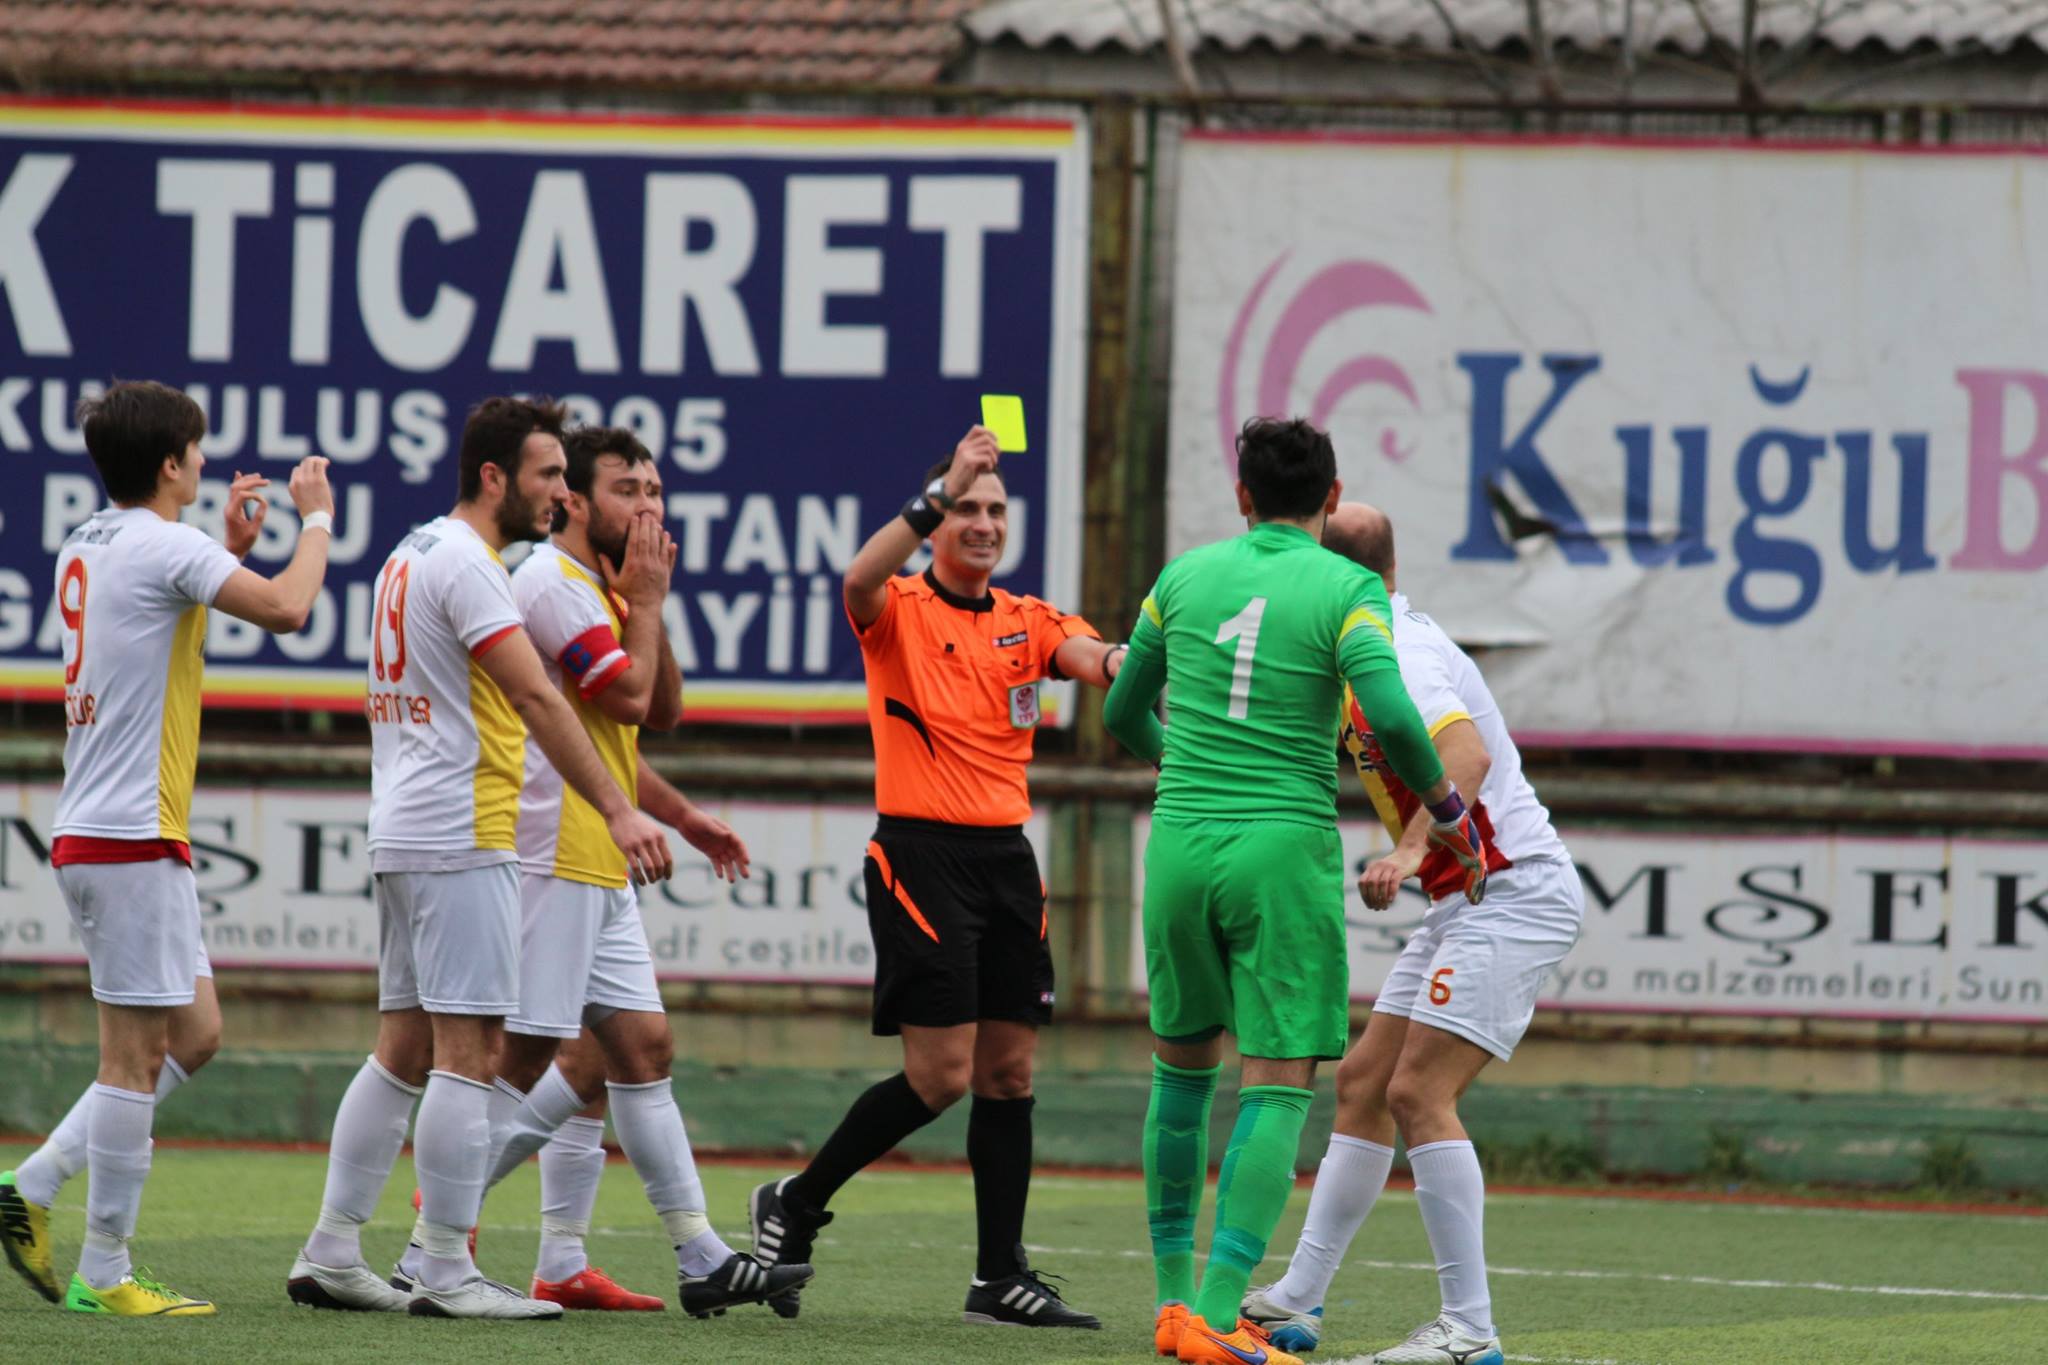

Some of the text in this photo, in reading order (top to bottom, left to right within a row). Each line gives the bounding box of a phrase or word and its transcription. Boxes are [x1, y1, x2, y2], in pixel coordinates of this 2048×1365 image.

[59, 557, 88, 685] 9
[1214, 596, 1268, 720] 1
[1430, 968, 1454, 1006] 6
